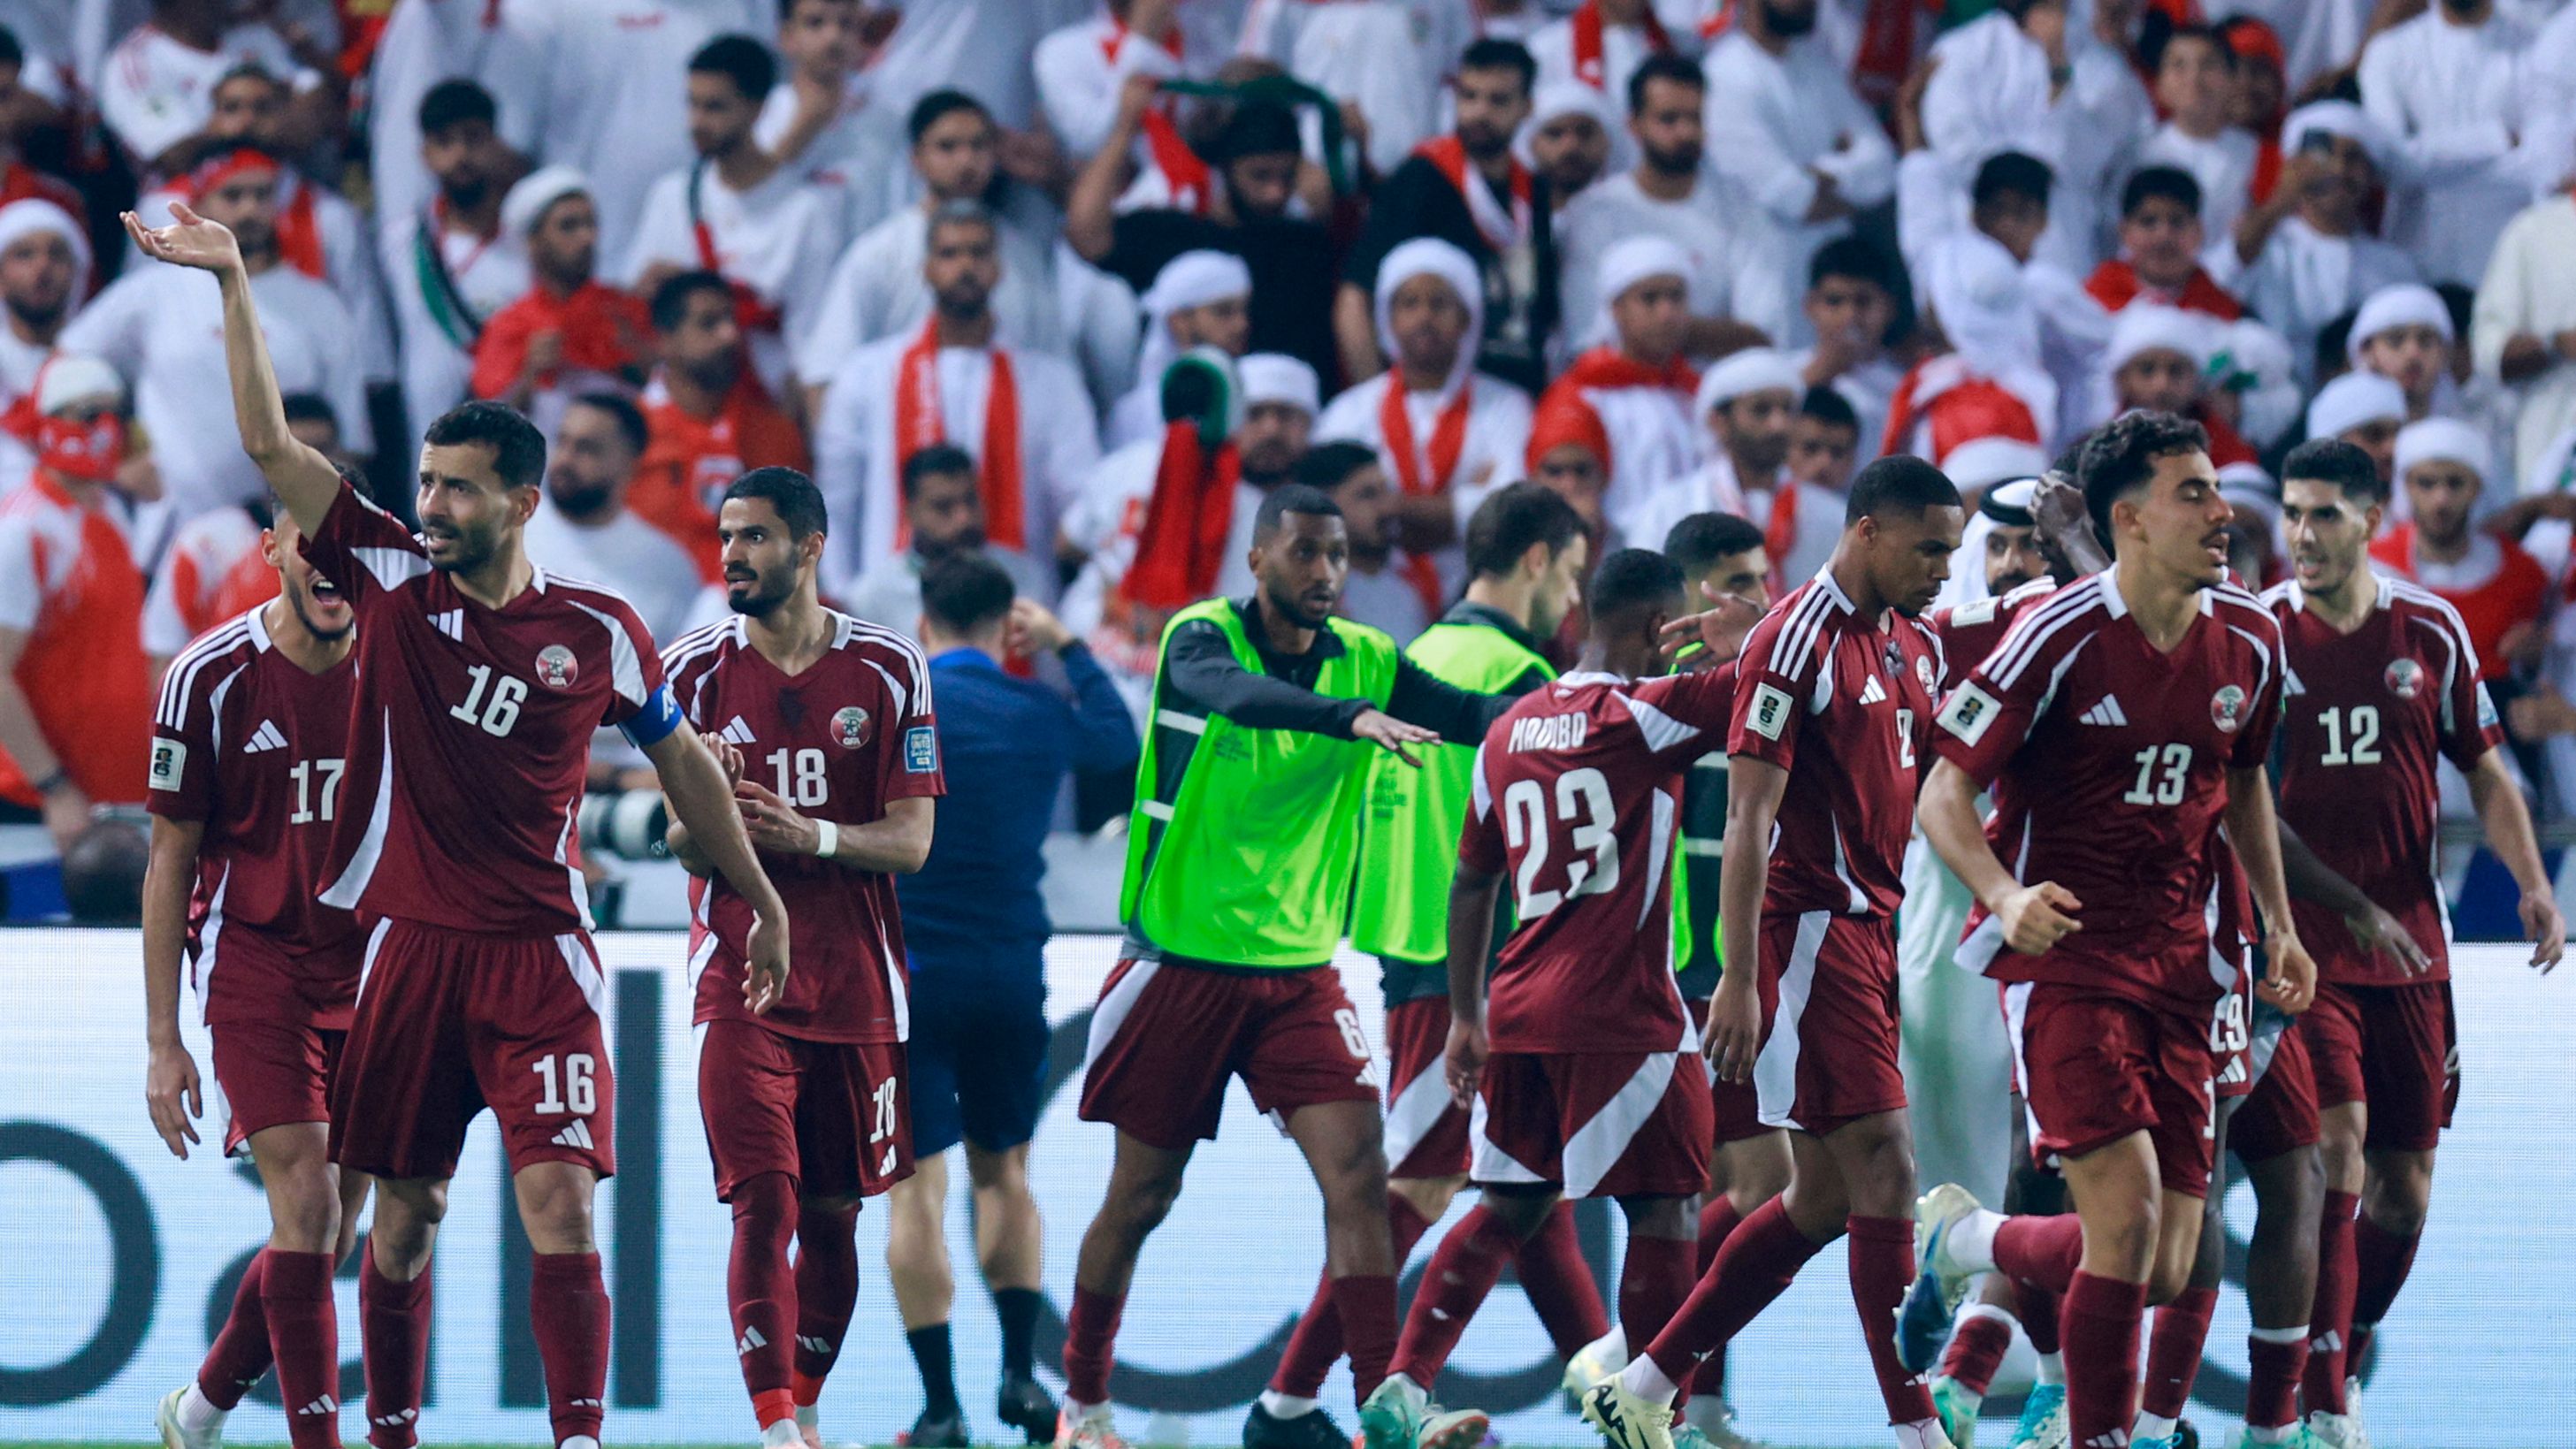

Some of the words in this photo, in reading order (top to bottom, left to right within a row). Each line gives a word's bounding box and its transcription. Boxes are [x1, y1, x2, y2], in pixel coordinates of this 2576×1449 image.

[450, 666, 528, 737] 16
[1508, 711, 1588, 755] MADIBO
[1895, 709, 1915, 769] 2
[2318, 705, 2381, 766] 12
[290, 759, 346, 824] 17
[765, 748, 829, 808] 18
[2124, 744, 2192, 806] 13
[1504, 767, 1620, 921] 23
[532, 1053, 596, 1115] 16
[869, 1076, 898, 1142] 18
